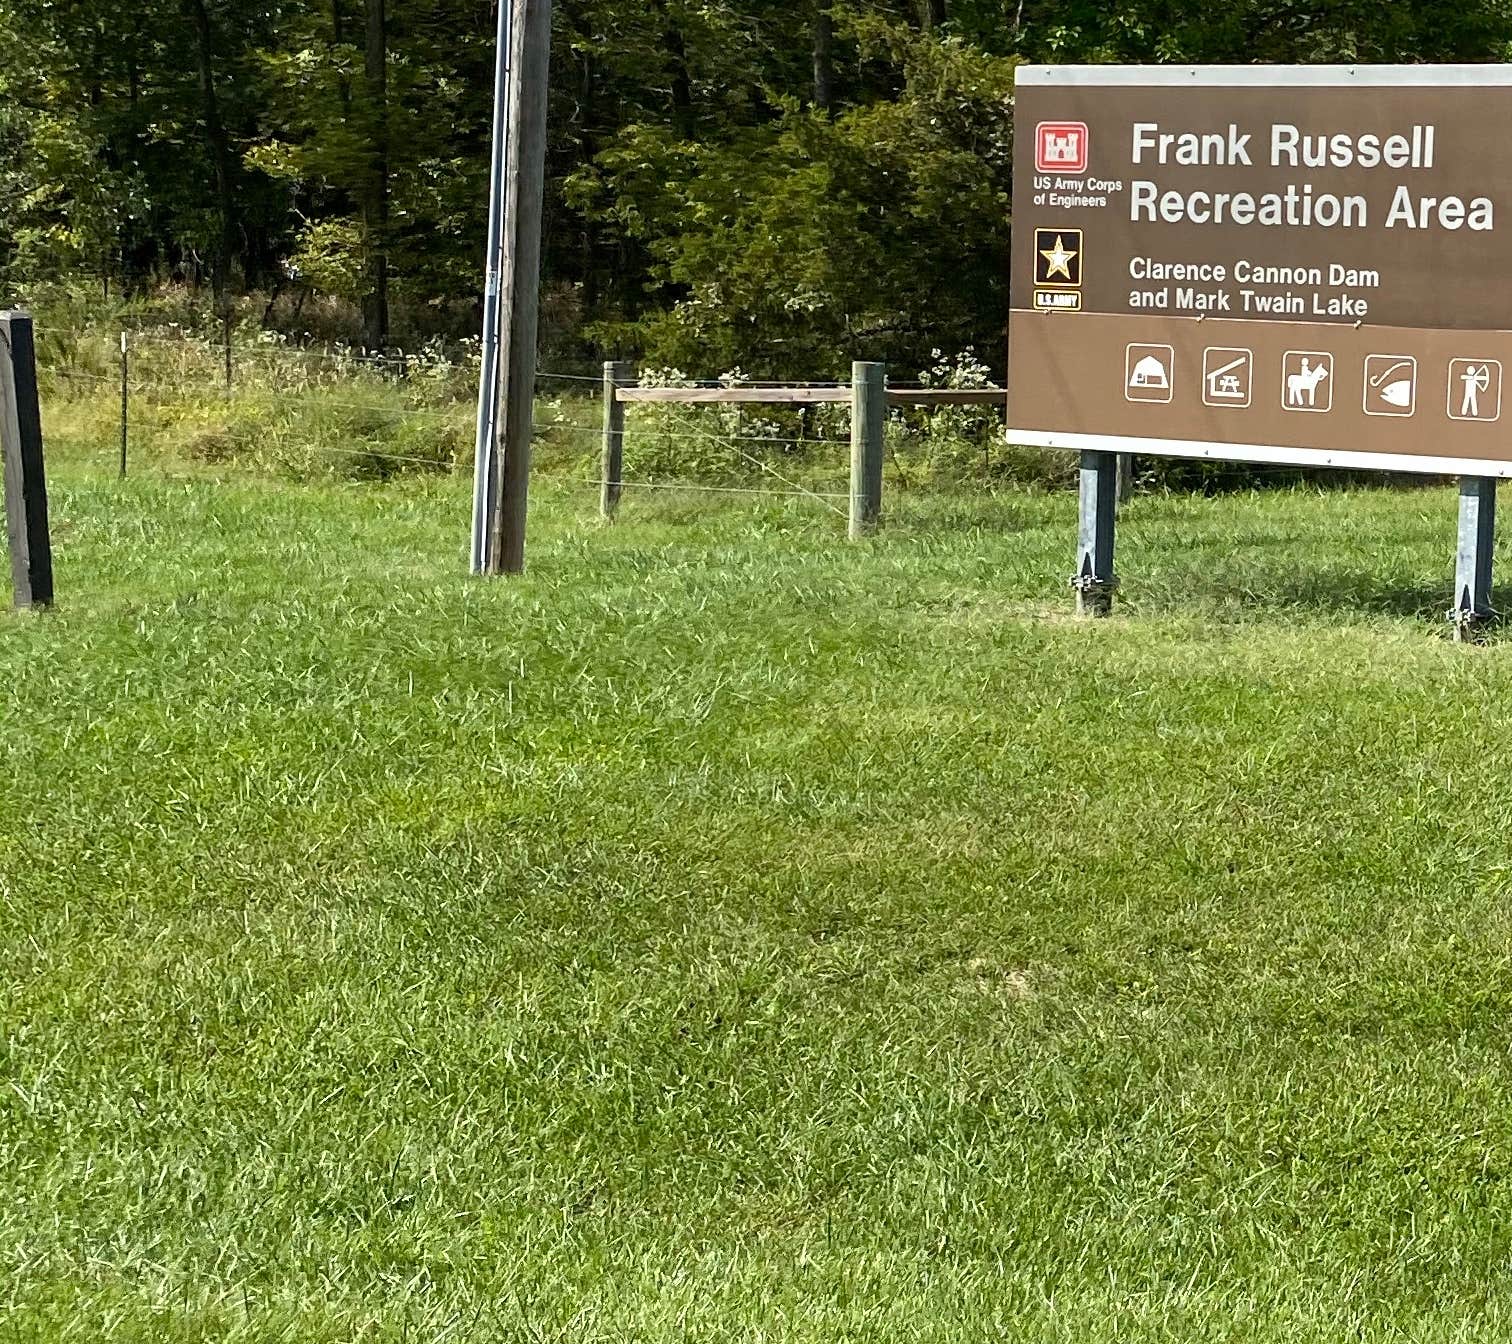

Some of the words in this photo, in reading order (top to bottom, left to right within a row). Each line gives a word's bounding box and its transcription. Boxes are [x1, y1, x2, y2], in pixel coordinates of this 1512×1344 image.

[1132, 123, 1253, 166] Frank
[1270, 124, 1435, 168] Russell
[1033, 176, 1051, 190] US
[1054, 177, 1084, 193] Army
[1087, 177, 1123, 194] Corps
[1033, 193, 1046, 206] of
[1049, 193, 1107, 209] Engineers
[1130, 181, 1367, 227] Recreation
[1384, 186, 1494, 231] Area
[1129, 256, 1226, 281] Clarence
[1233, 260, 1322, 285] Cannon
[1328, 264, 1380, 288] Dam
[1128, 287, 1168, 308] and
[1175, 287, 1231, 311] Mark
[1239, 290, 1305, 314] Twain
[1312, 293, 1368, 316] Lake
